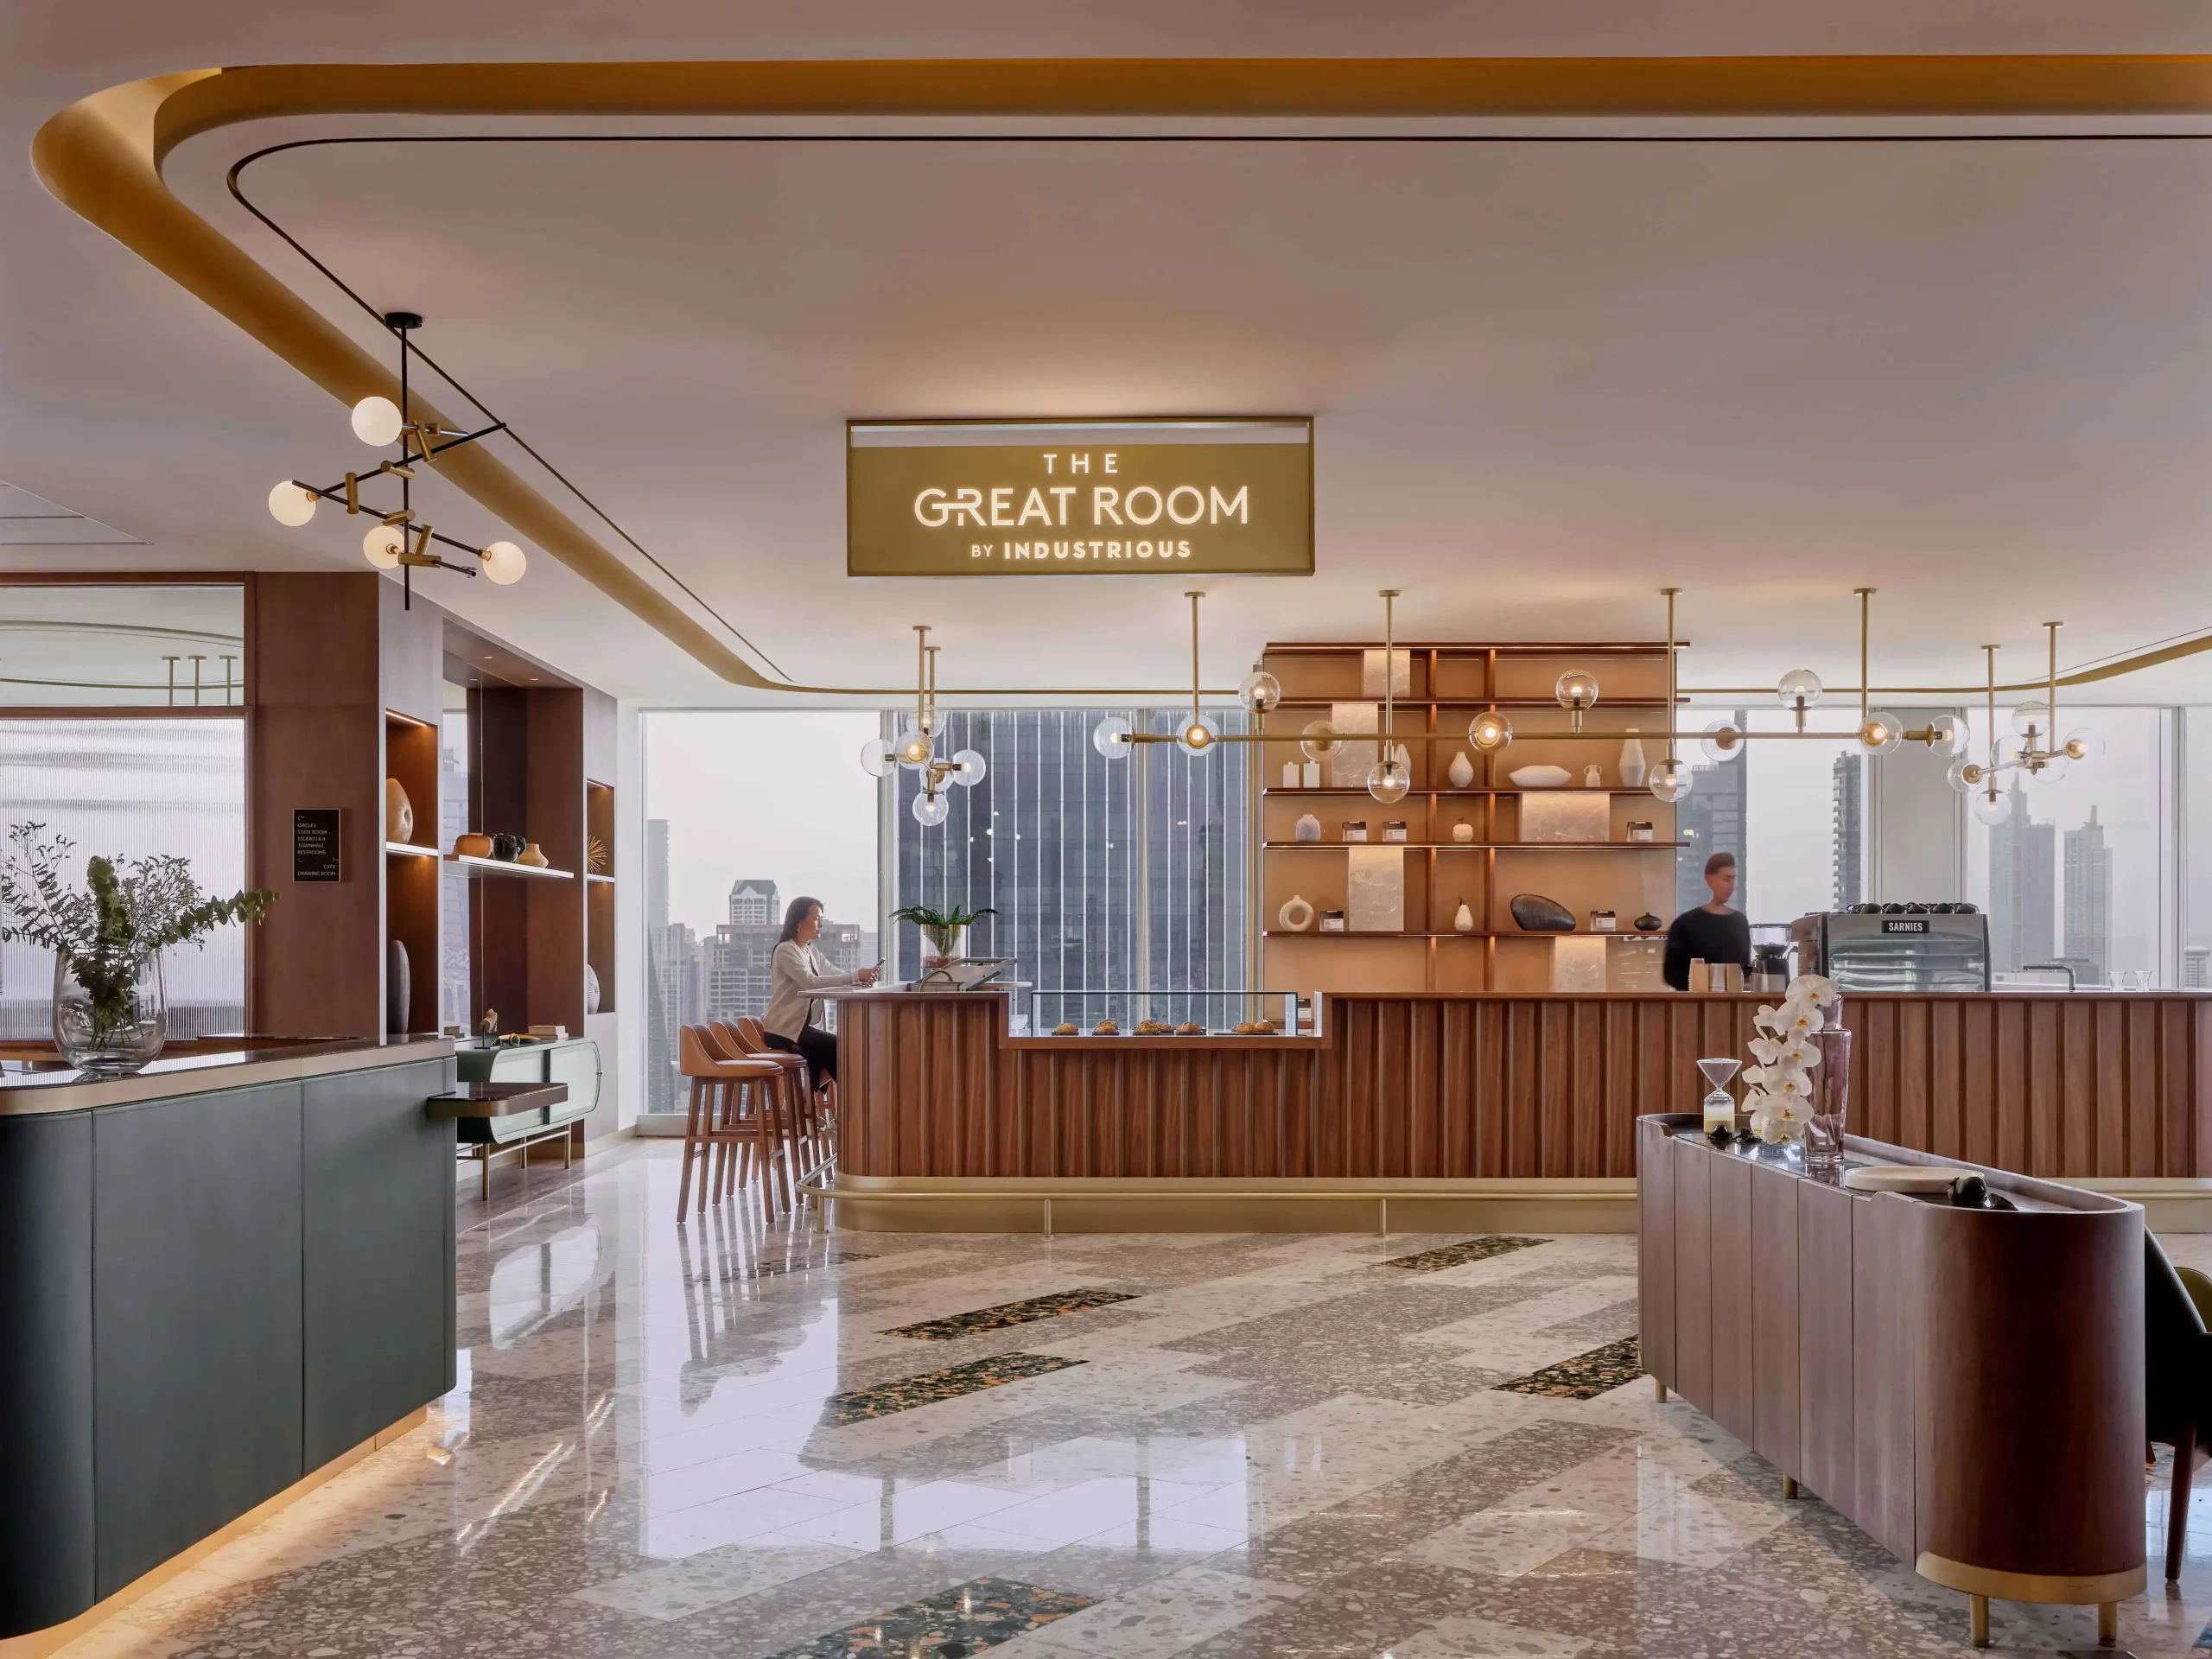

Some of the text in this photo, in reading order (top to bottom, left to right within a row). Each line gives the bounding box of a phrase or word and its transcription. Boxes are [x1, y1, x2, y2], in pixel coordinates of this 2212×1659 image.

[1043, 453, 1118, 474] THE
[913, 485, 1249, 527] GREAT ROOM
[971, 540, 1192, 559] BY INDUSTRIOUS
[1888, 922, 1923, 931] SARNIES
